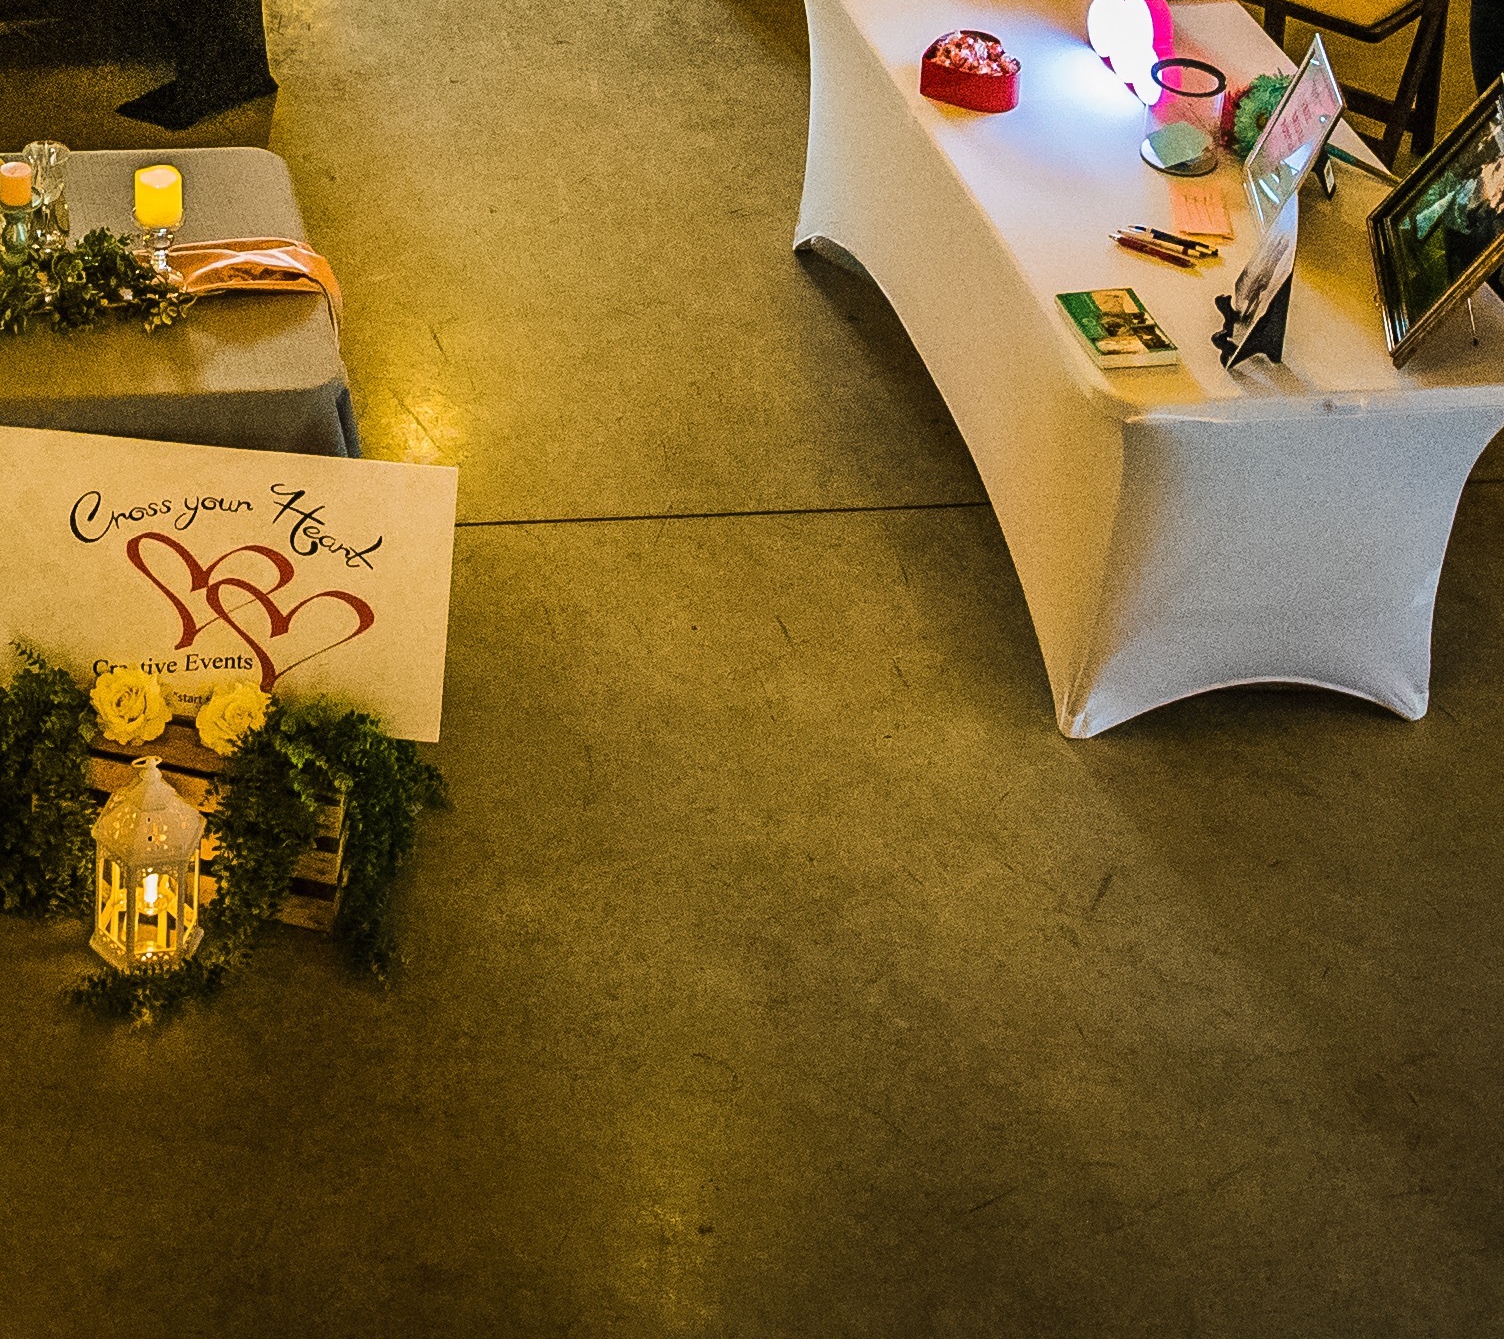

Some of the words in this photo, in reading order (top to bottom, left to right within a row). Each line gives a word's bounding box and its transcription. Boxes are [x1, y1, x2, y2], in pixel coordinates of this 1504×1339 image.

[69, 490, 173, 544] Cross
[174, 496, 254, 531] your
[271, 483, 383, 571] Heart
[93, 657, 178, 676] Crtive
[185, 654, 254, 672] Events
